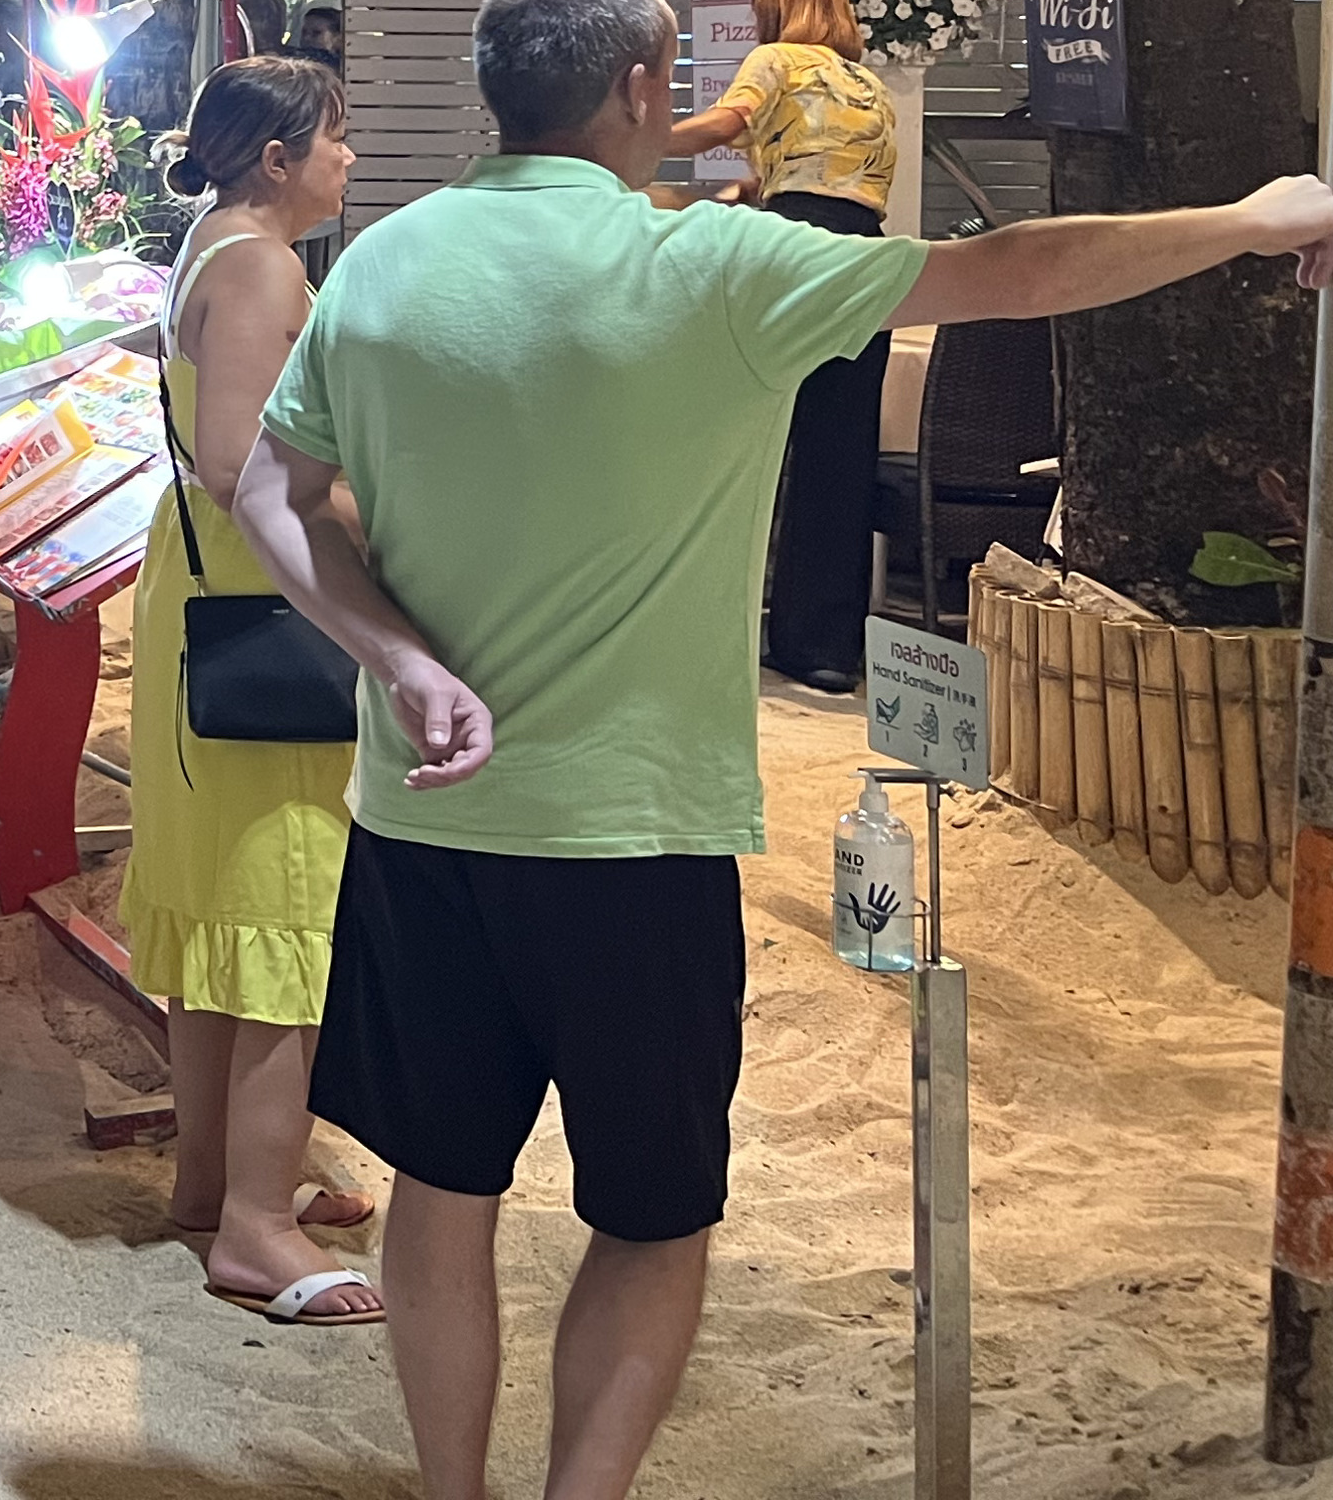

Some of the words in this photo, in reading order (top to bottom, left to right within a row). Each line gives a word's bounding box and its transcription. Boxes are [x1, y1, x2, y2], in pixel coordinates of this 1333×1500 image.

[711, 23, 757, 43] Pizz
[1055, 41, 1094, 61] FREE
[873, 661, 901, 682] Hand
[835, 848, 865, 867] AND
